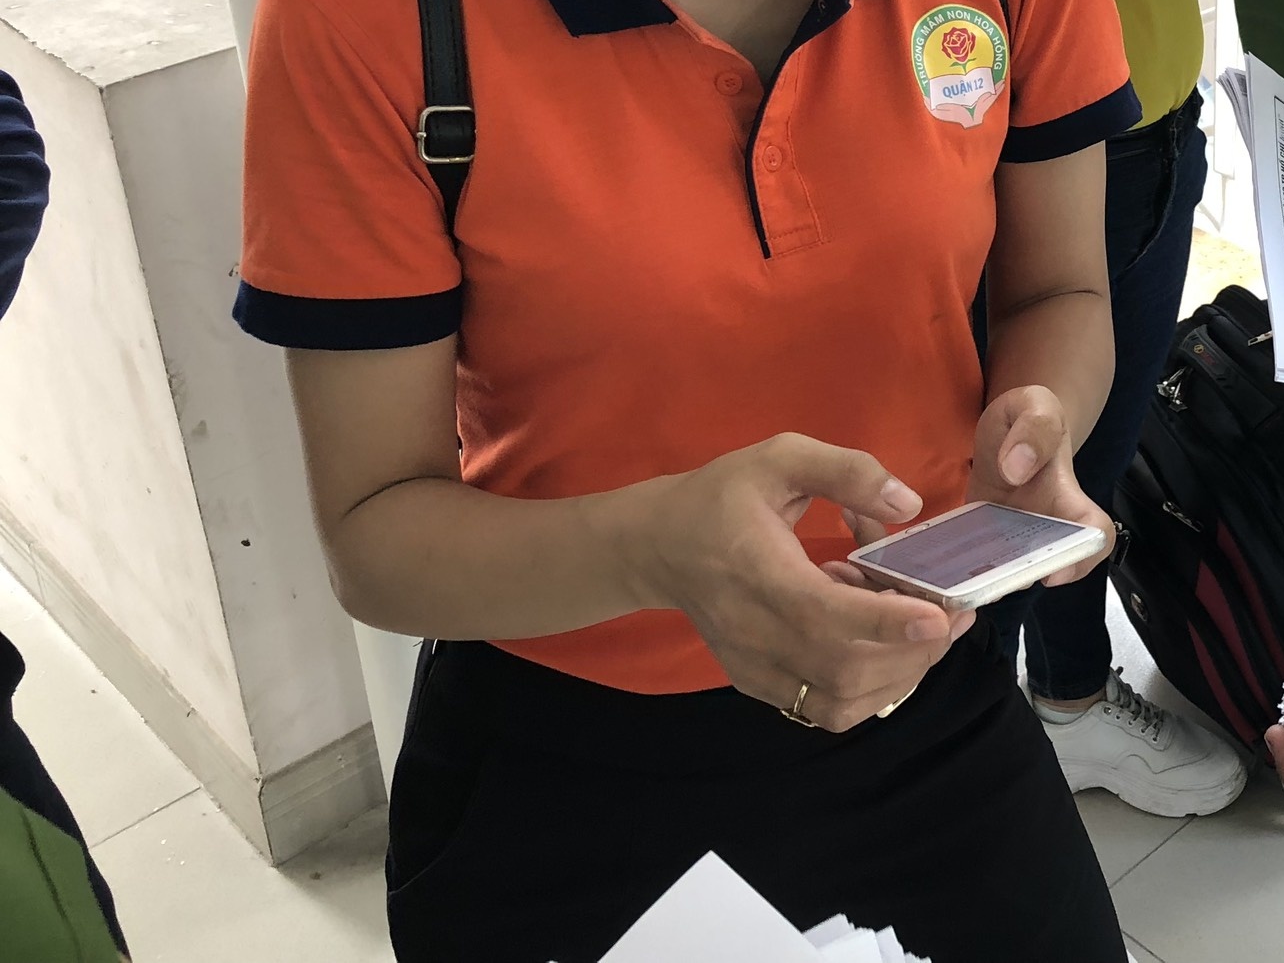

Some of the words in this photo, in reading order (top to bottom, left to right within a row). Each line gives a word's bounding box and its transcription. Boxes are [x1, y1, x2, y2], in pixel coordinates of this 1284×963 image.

[946, 10, 971, 21] NON
[973, 15, 994, 36] HOA
[942, 80, 973, 97] QUẬN
[973, 78, 984, 90] 12
